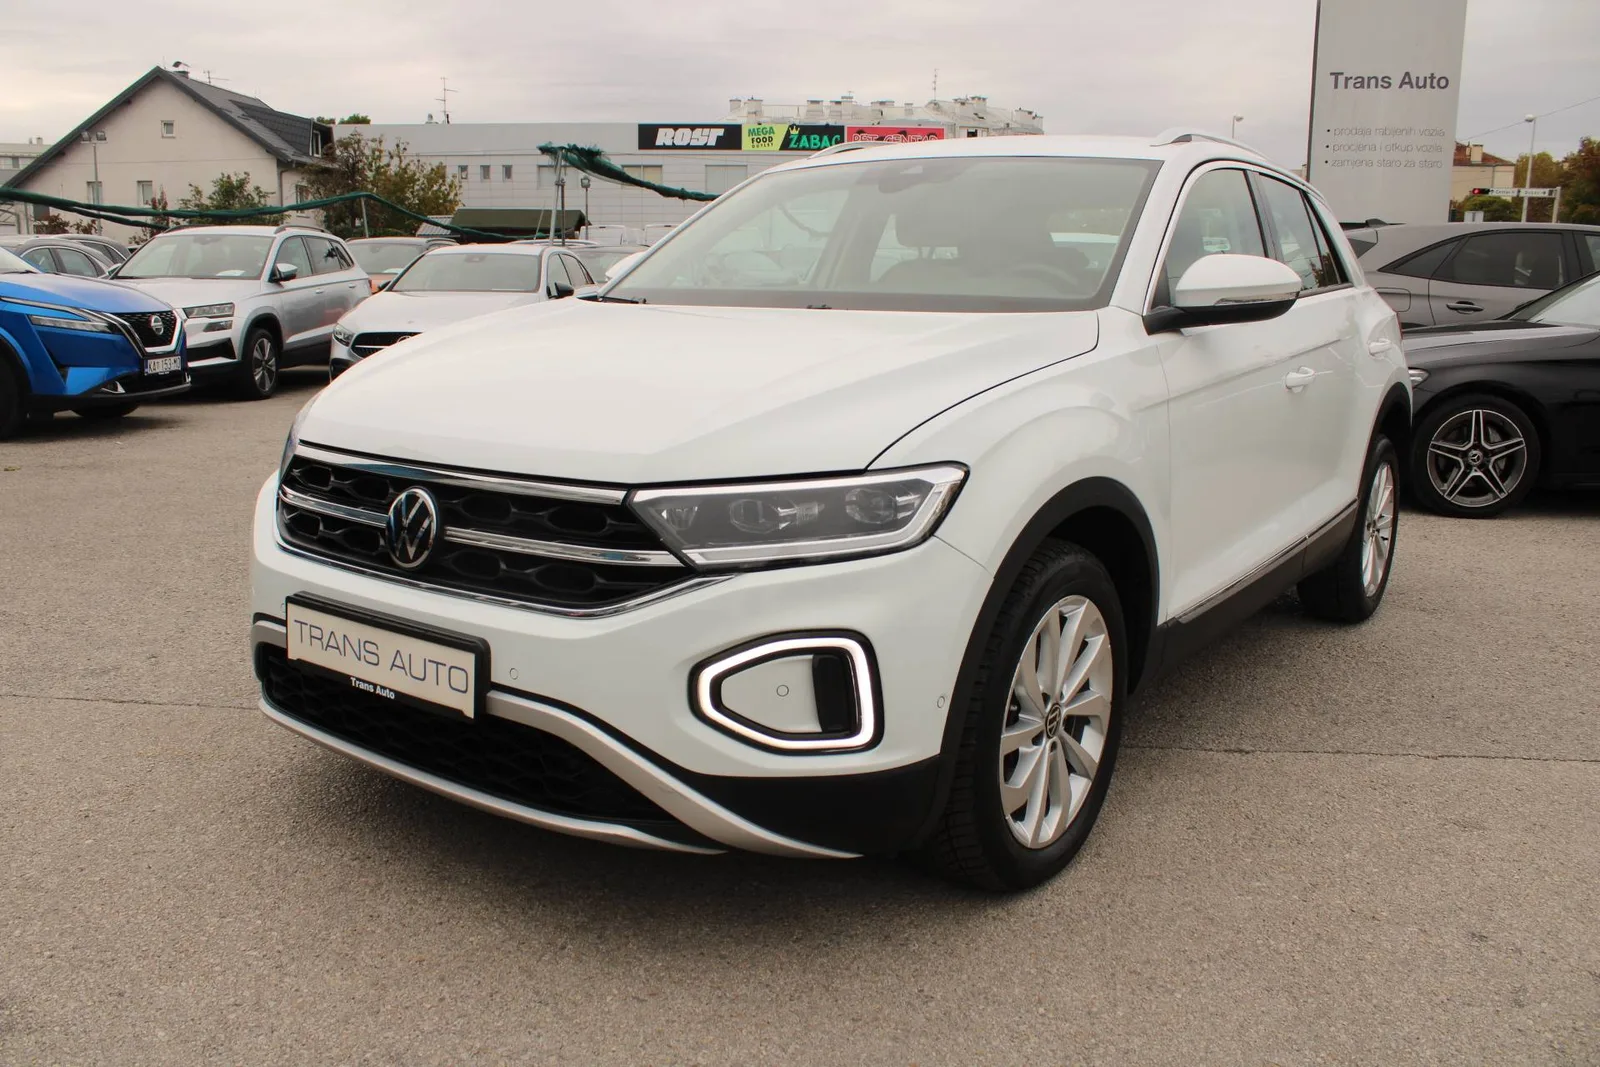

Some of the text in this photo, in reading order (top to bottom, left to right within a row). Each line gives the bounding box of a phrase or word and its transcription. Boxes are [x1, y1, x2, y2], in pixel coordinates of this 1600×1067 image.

[1329, 71, 1450, 90] Trans Auto
[655, 127, 725, 146] ROST
[747, 126, 775, 137] MEGA
[1333, 126, 1372, 138] prodaja
[1419, 127, 1446, 137] vozila
[751, 136, 774, 144] FOOD
[1332, 142, 1377, 154] procjena
[1384, 143, 1414, 154] otkup
[1415, 143, 1443, 153] vozila
[1331, 159, 1443, 169] zamjena staro za staro
[294, 619, 469, 694] TRANS AUTO
[350, 676, 395, 700] Trans Auto
